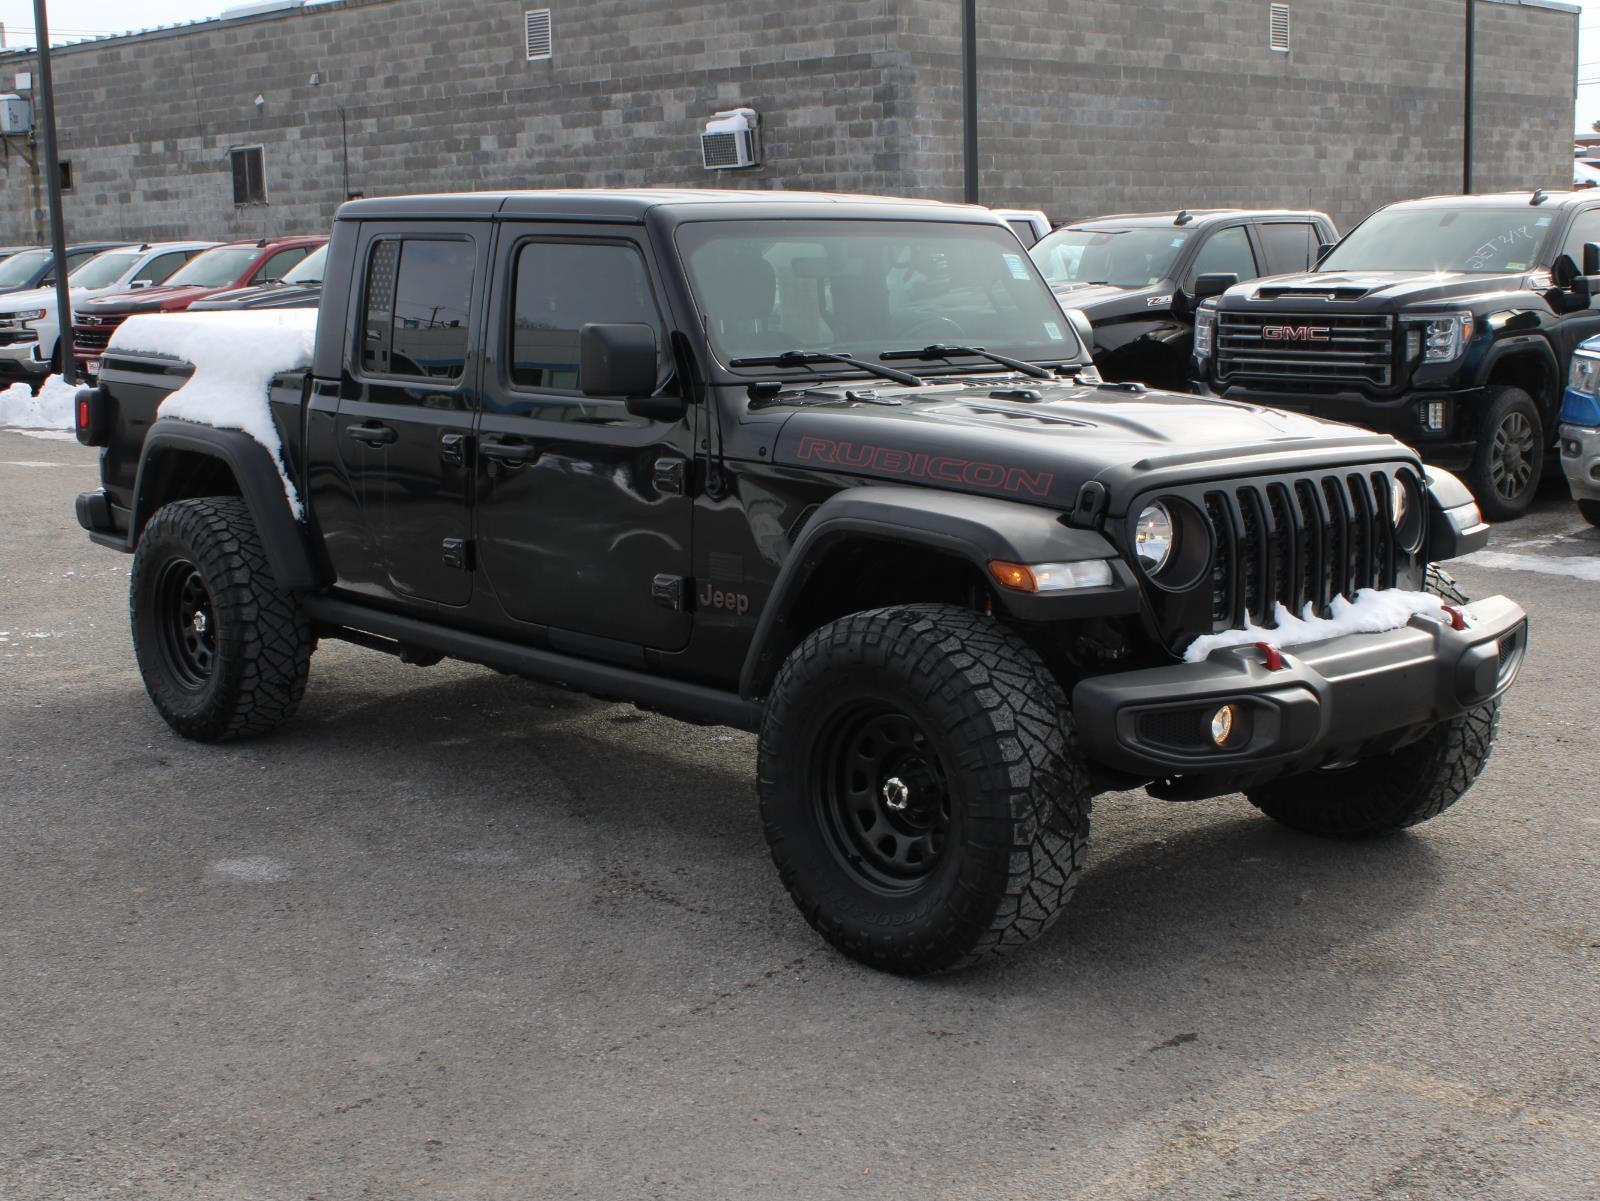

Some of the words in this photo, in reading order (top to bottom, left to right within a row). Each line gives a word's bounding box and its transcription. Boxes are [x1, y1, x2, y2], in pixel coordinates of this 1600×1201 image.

[1262, 325, 1330, 341] GMC
[796, 435, 1054, 496] RUBICON
[699, 583, 749, 616] Jeep
